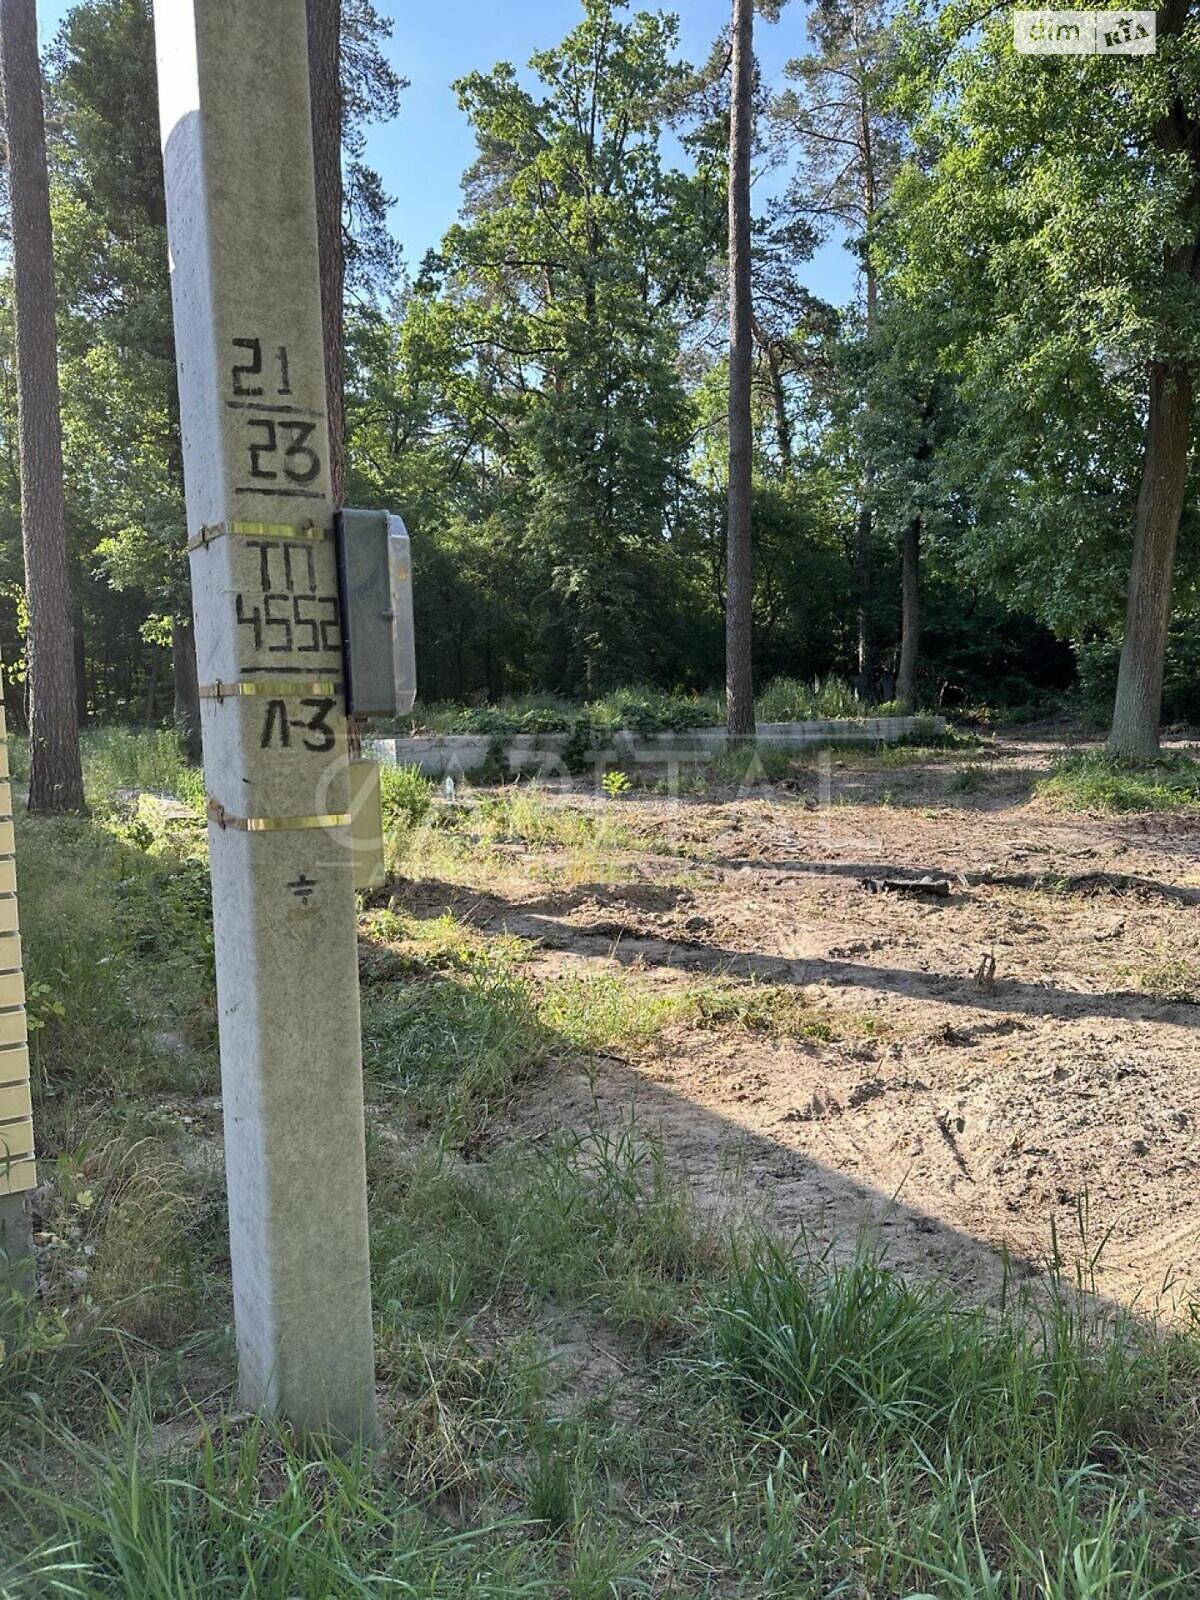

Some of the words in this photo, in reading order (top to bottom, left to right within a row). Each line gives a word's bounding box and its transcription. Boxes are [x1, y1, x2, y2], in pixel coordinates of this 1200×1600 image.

[231, 337, 293, 396] 21
[247, 419, 321, 483] 23
[246, 541, 318, 593] ТП
[235, 594, 342, 652] 4552
